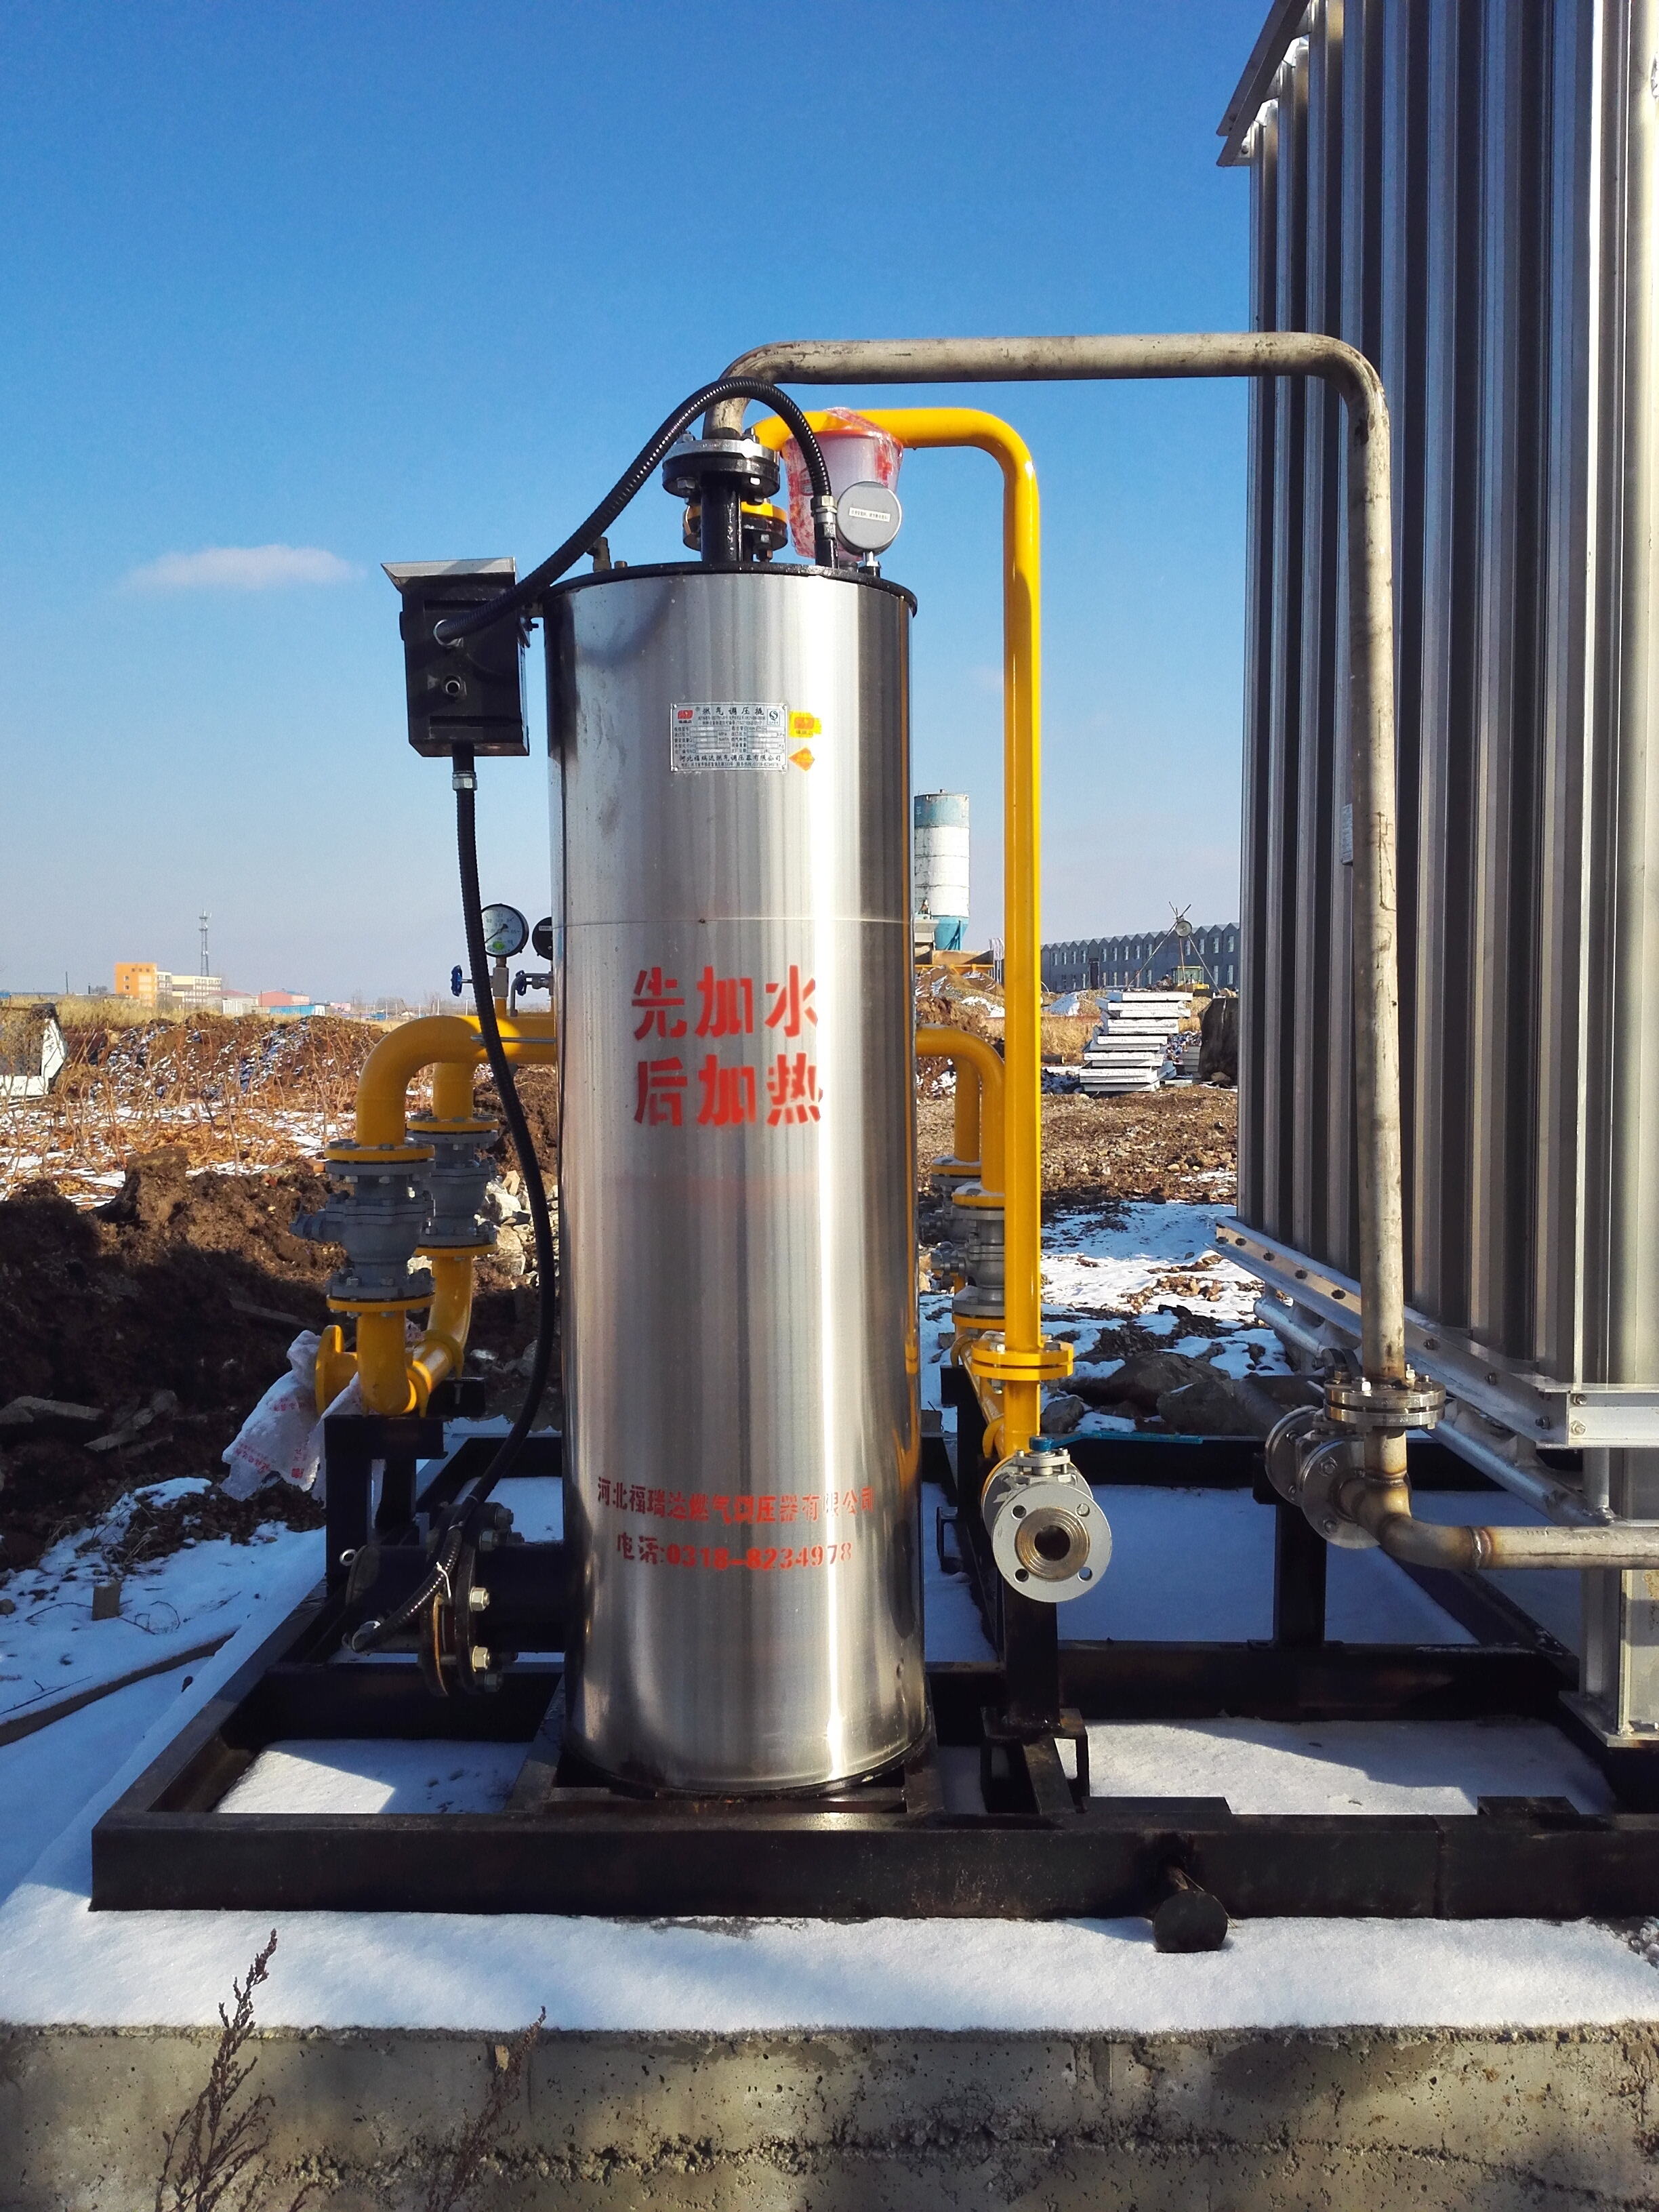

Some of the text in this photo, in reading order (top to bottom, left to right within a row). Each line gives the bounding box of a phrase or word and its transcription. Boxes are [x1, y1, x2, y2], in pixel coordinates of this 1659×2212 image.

[632, 965, 818, 1040] 先加水
[634, 1052, 823, 1126] 后加热
[598, 1477, 874, 1525] 河北福瑞达燃气调压器有限公司
